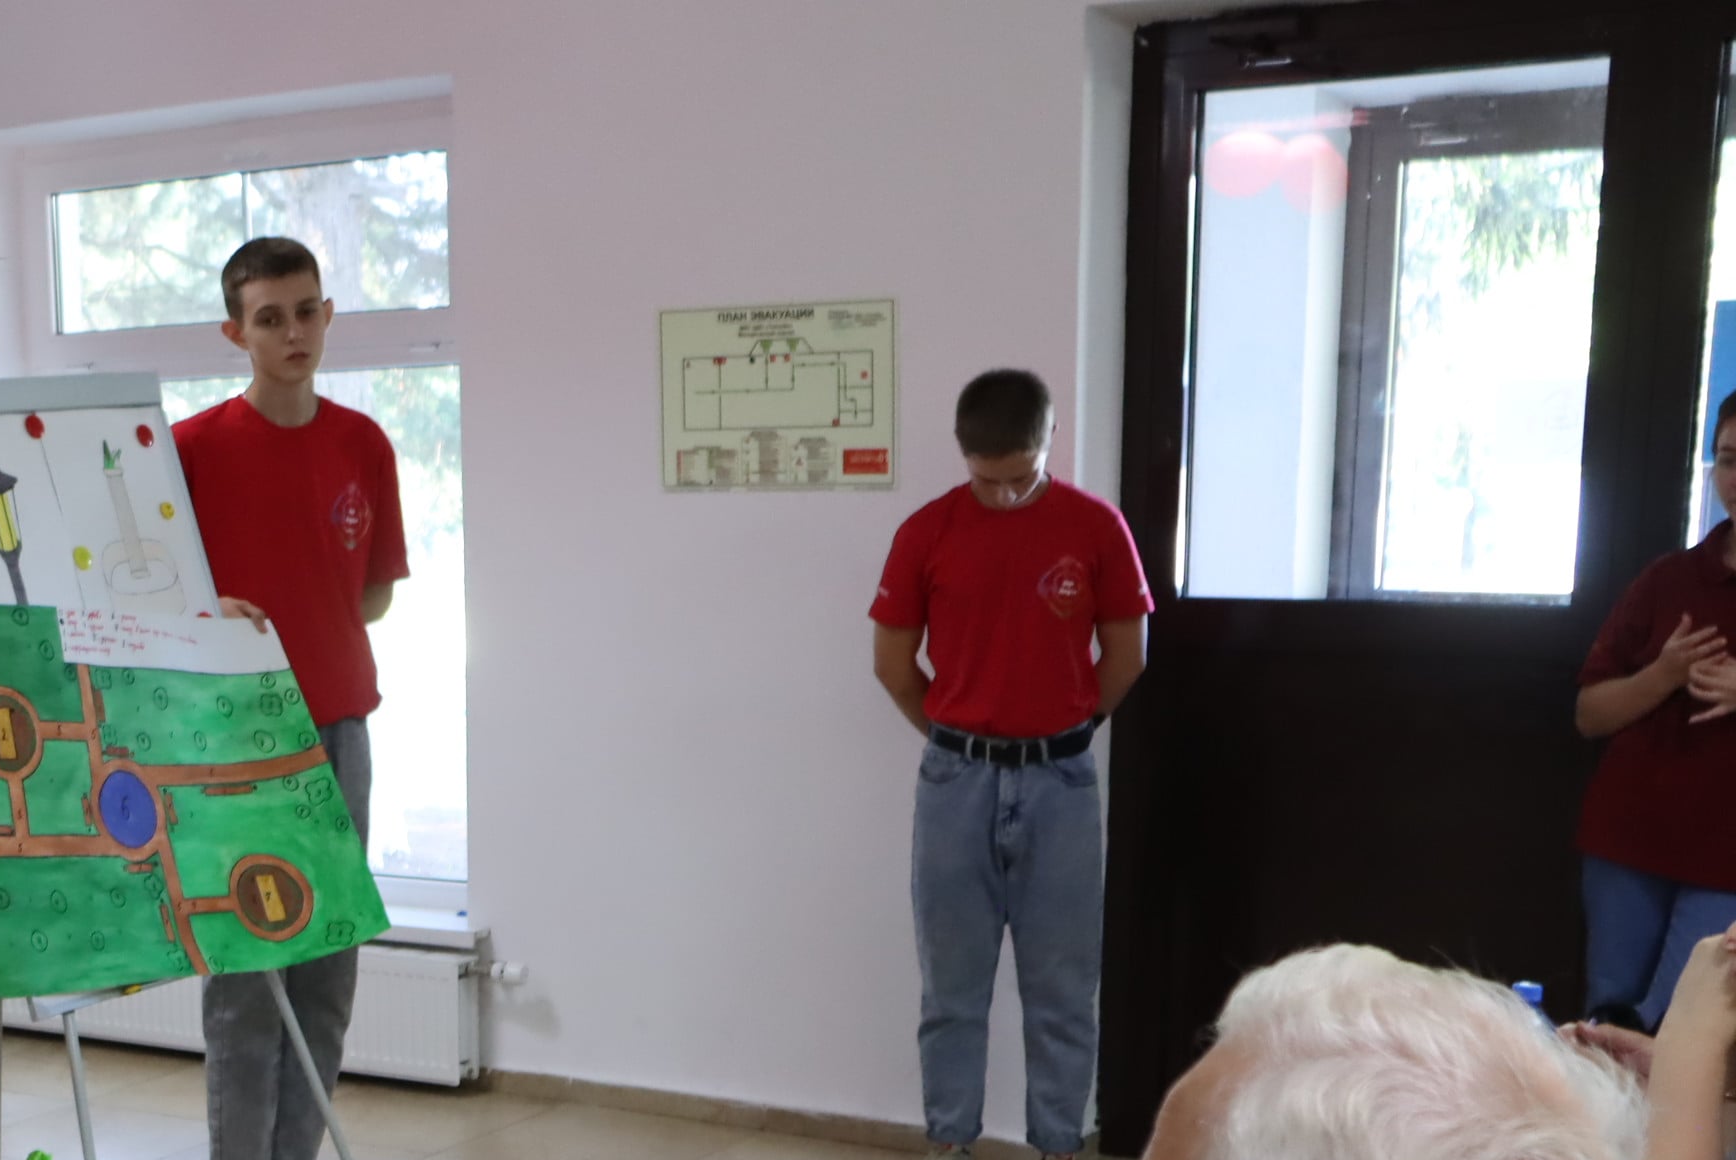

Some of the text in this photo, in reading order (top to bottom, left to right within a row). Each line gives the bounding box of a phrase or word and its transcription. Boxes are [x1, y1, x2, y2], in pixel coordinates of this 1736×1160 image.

[717, 311, 747, 322] ПЛАН
[750, 308, 815, 321] ЭВАКУАЦИИ
[121, 795, 131, 822] 6
